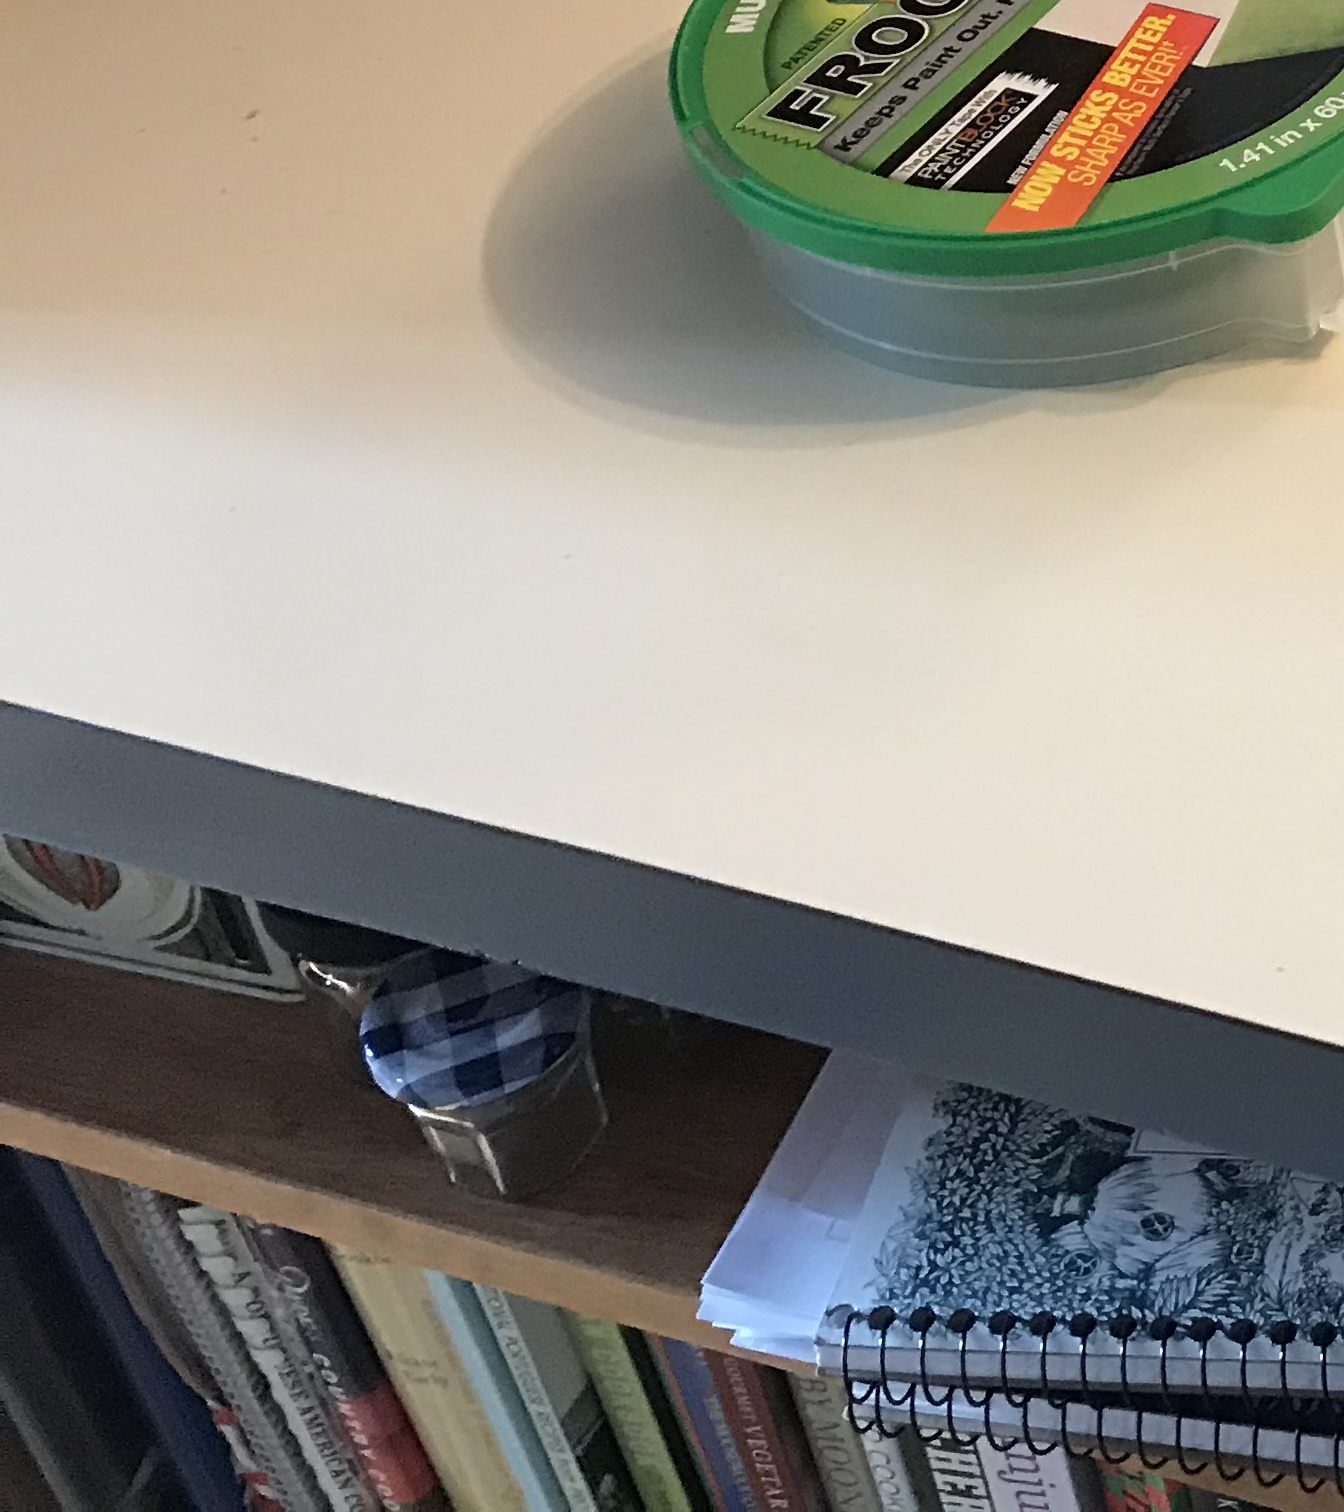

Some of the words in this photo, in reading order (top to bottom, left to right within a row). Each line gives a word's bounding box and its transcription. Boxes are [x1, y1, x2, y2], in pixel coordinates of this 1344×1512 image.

[781, 17, 847, 70] PATENTED
[834, 94, 908, 153] Keeps
[903, 43, 960, 91] Paint
[956, 9, 1004, 43] Out.
[918, 128, 952, 158] ONLY
[934, 97, 1028, 181] TECHNOLOGY
[1011, 160, 1067, 212] NOW
[1050, 89, 1120, 161] STICKS
[1101, 13, 1178, 88] BETTER.
[1067, 122, 1127, 186] SHARP
[1111, 98, 1148, 127] AS
[1219, 141, 1275, 172] 1.41
[1269, 129, 1303, 148] in
